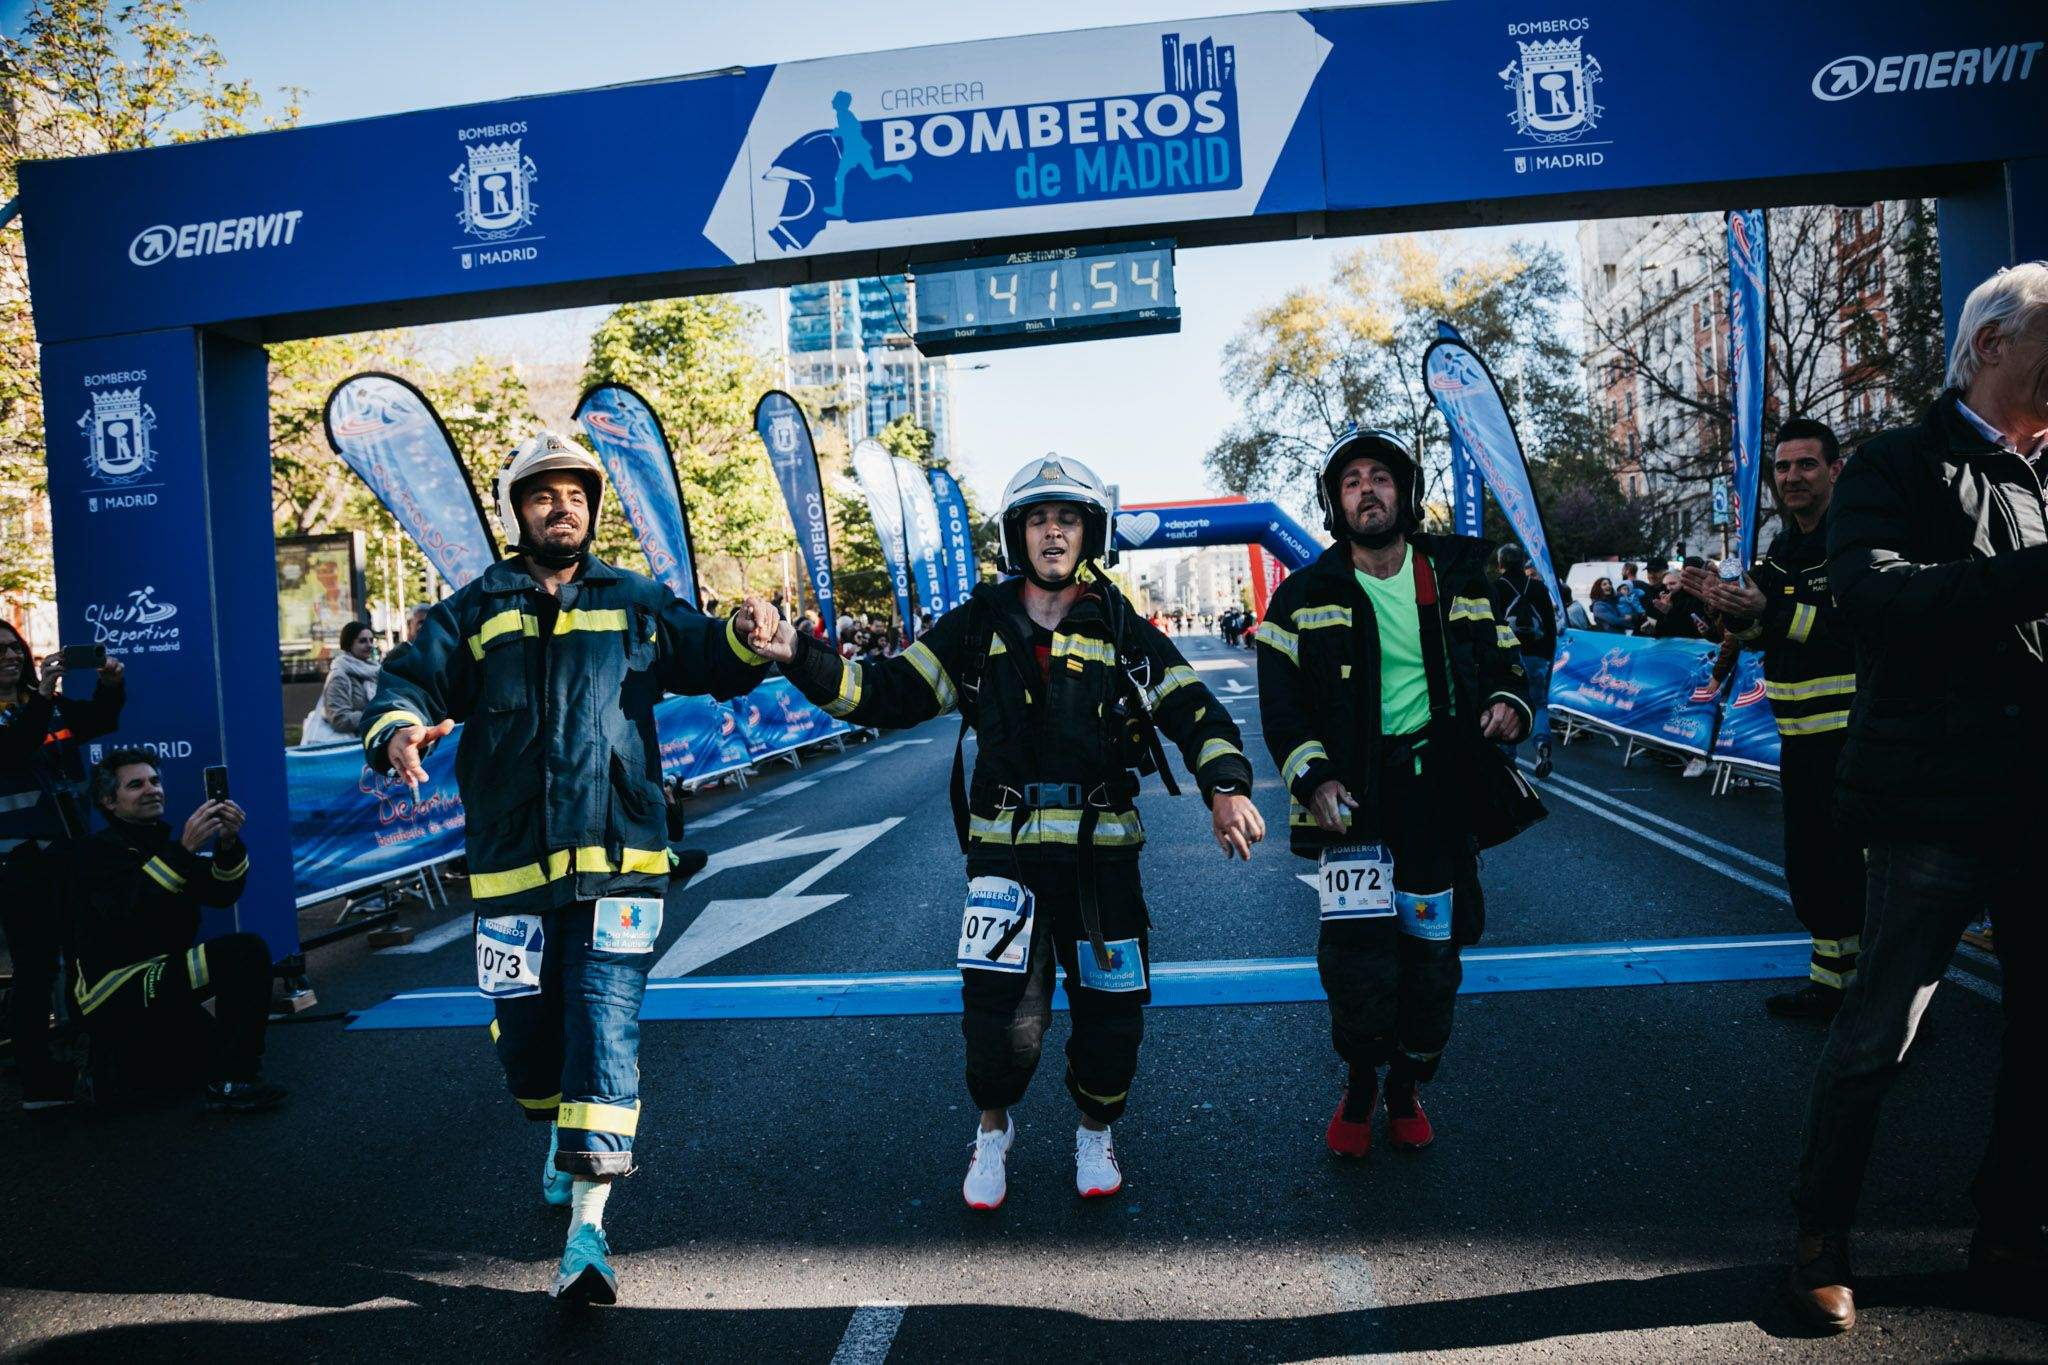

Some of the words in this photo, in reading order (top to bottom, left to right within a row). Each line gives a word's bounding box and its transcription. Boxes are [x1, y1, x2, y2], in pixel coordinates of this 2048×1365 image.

[1508, 17, 1590, 36] BOMBEROS
[1873, 41, 2045, 94] ENERVIT
[881, 81, 984, 111] CARRERA
[458, 121, 528, 141] BOMBEROS
[882, 89, 1226, 162] BOMBEROS
[1015, 153, 1061, 199] de
[1075, 136, 1231, 194] MADRID
[1536, 152, 1604, 170] MADRID
[175, 210, 303, 258] ENERVIT
[479, 246, 538, 264] MADRID
[955, 328, 976, 338] hour
[1025, 321, 1045, 330] min.
[84, 369, 147, 386] BOMBEROS
[105, 493, 158, 509] MADRID
[1279, 530, 1311, 559] MADRID
[85, 604, 124, 623] Club
[94, 621, 180, 646] Deportivo
[105, 646, 129, 655] beros
[133, 645, 144, 654] de
[149, 641, 181, 652] madrid
[1325, 867, 1382, 893] 1072
[963, 914, 1012, 941] 071
[477, 943, 521, 979] 1073
[1104, 970, 1135, 980] Mundial
